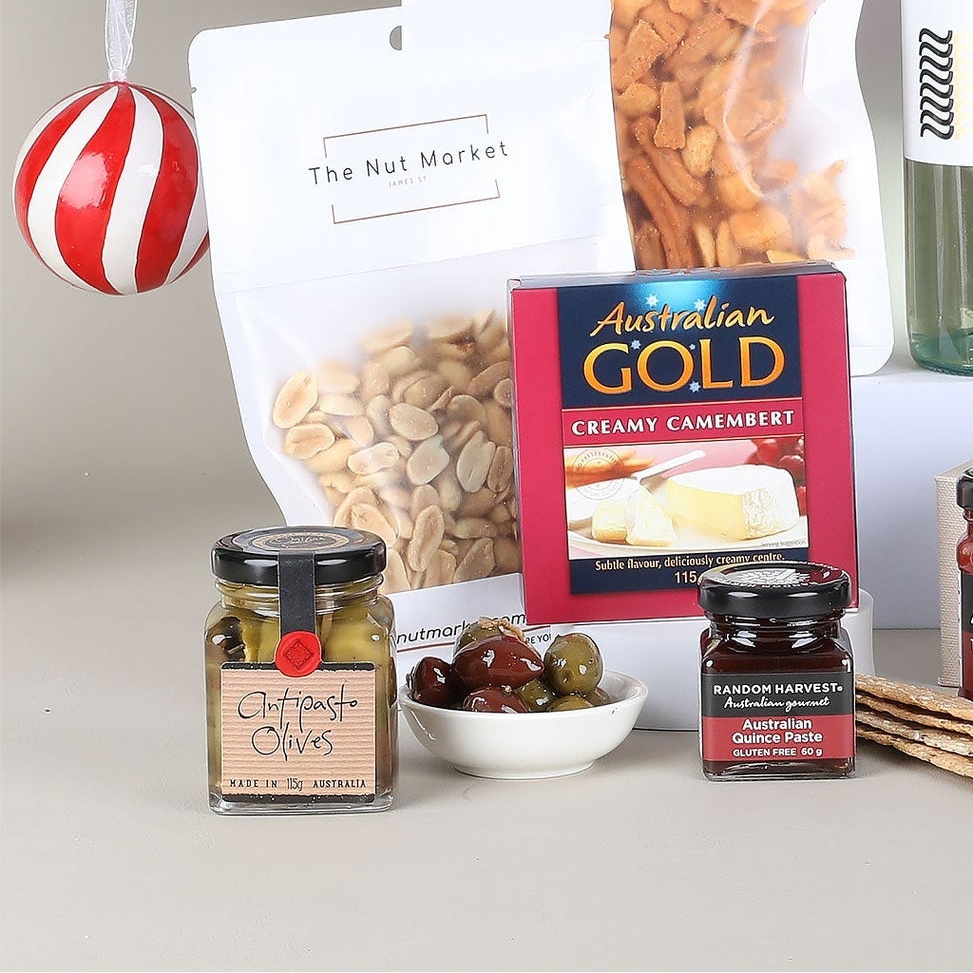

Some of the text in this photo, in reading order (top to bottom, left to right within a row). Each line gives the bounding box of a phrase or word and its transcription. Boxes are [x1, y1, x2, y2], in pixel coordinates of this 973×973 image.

[308, 141, 508, 185] The Nut Market
[590, 295, 775, 337] Australian
[583, 336, 785, 394] GOLD
[572, 410, 794, 436] CREAMY CAMEMBERT
[595, 552, 785, 571] Subtle flavour, deliciously creamy centre.
[713, 685, 771, 695] RANDOM
[724, 696, 829, 712] Australian gourmet
[742, 719, 812, 730] Australian
[251, 722, 334, 761] Olives
[732, 732, 823, 744] Quince Paste
[733, 748, 770, 757] GLUTEN
[773, 748, 796, 757] FREE
[801, 748, 814, 756] 60
[230, 778, 367, 792] MADE IN 115g AUSTRALIA
